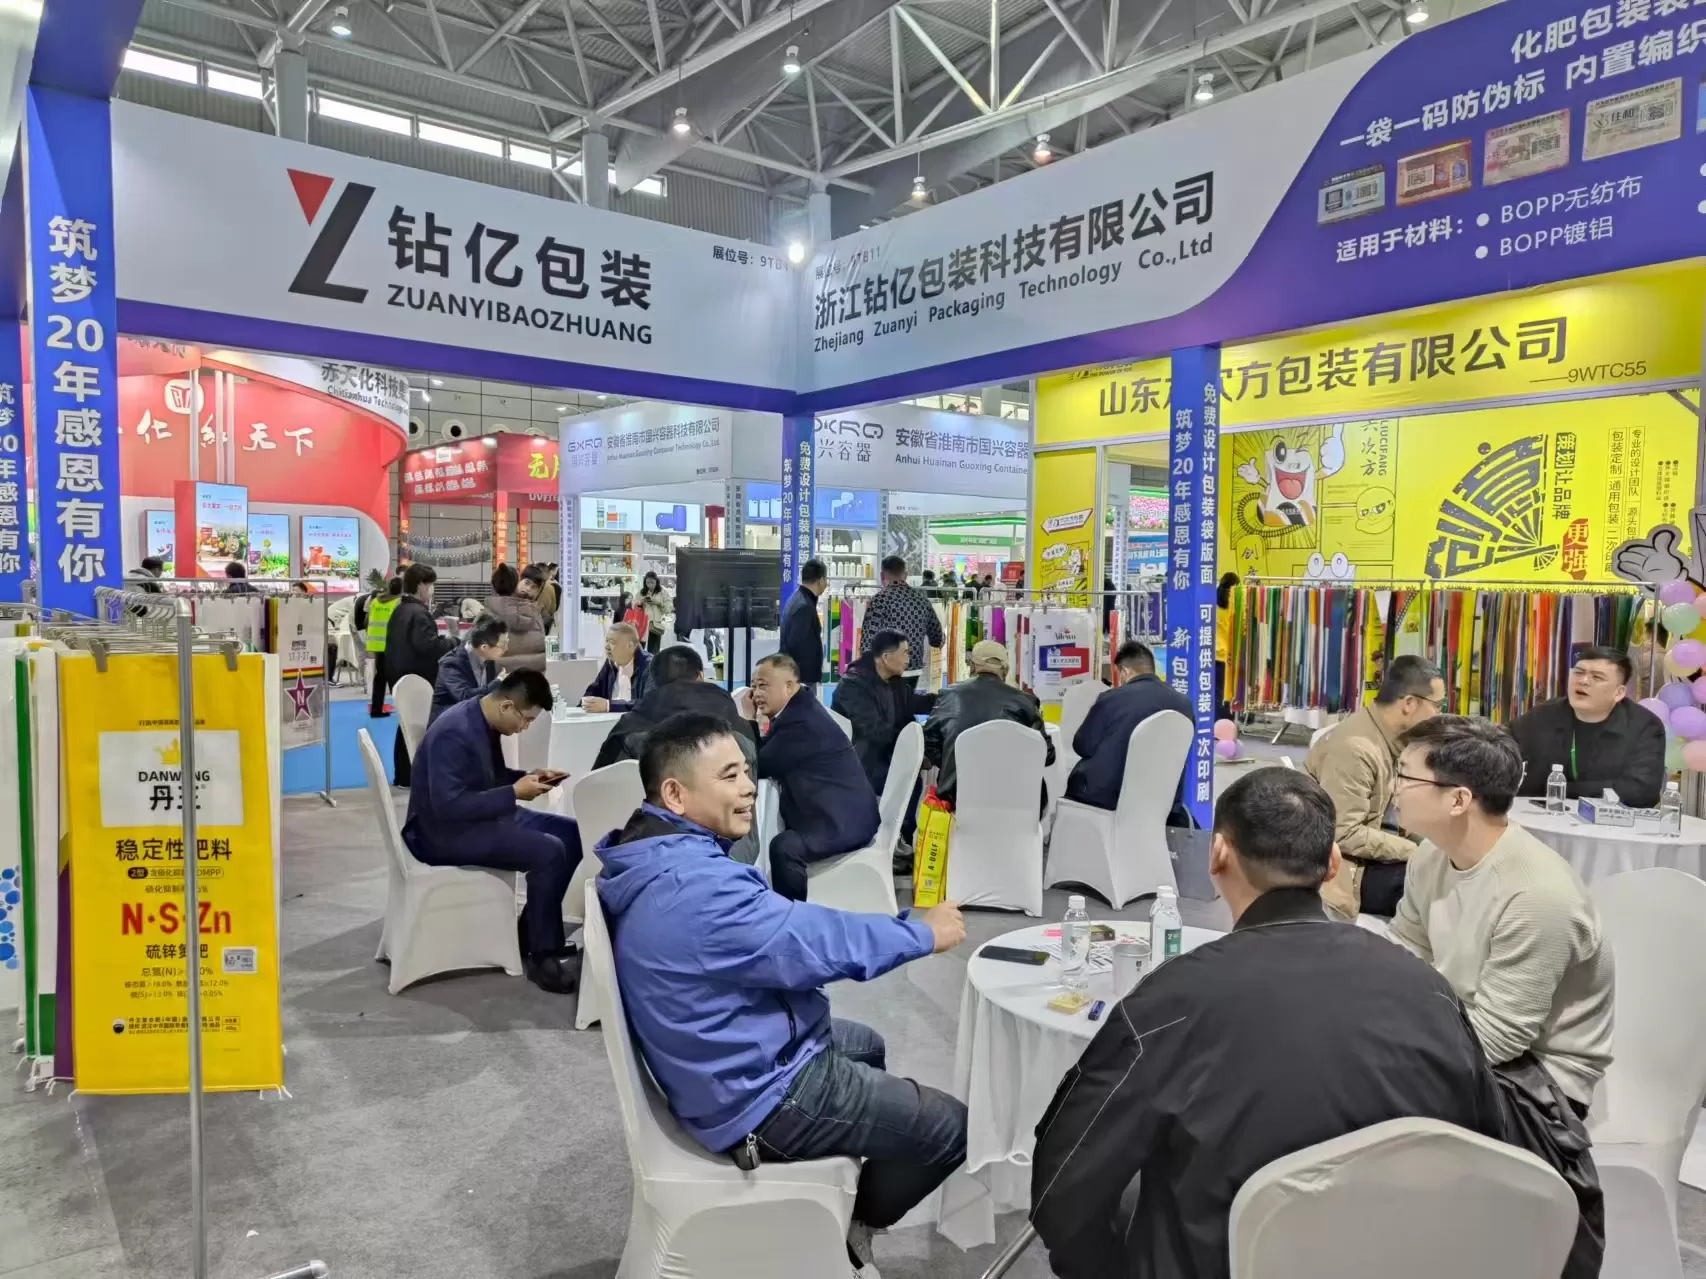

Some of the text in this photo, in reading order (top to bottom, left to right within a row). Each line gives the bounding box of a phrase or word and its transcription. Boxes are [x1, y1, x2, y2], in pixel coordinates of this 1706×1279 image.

[1510, 0, 1706, 64] 化肥包装
[1340, 69, 1546, 148] 一袋一码防伪标
[814, 170, 1215, 330] 浙江钻亿包装科技有限公司
[1500, 216, 1613, 256] BOPP镀铝
[1501, 175, 1643, 224] BOPP无纺布
[387, 204, 652, 311] 钻亿包装
[814, 233, 1214, 353] Zhejiang Zuanyi Packaging Technology Co.,Ltd
[387, 284, 652, 345] ZUANYIBAOZHUANG
[45, 215, 106, 583] 筑梦20年感恩有你
[1099, 316, 1567, 417] 山东方包装有限公司
[0, 383, 21, 574] 筑梦0年感恩有你
[797, 440, 812, 585] 免费设计包装袋版
[895, 453, 921, 465] Anhui
[922, 456, 957, 469] Huainan
[959, 459, 992, 474] Guoxing
[1196, 382, 1217, 803] 免费设计包装袋版面 可提供包装二次印刷
[138, 771, 211, 782] DANWNG
